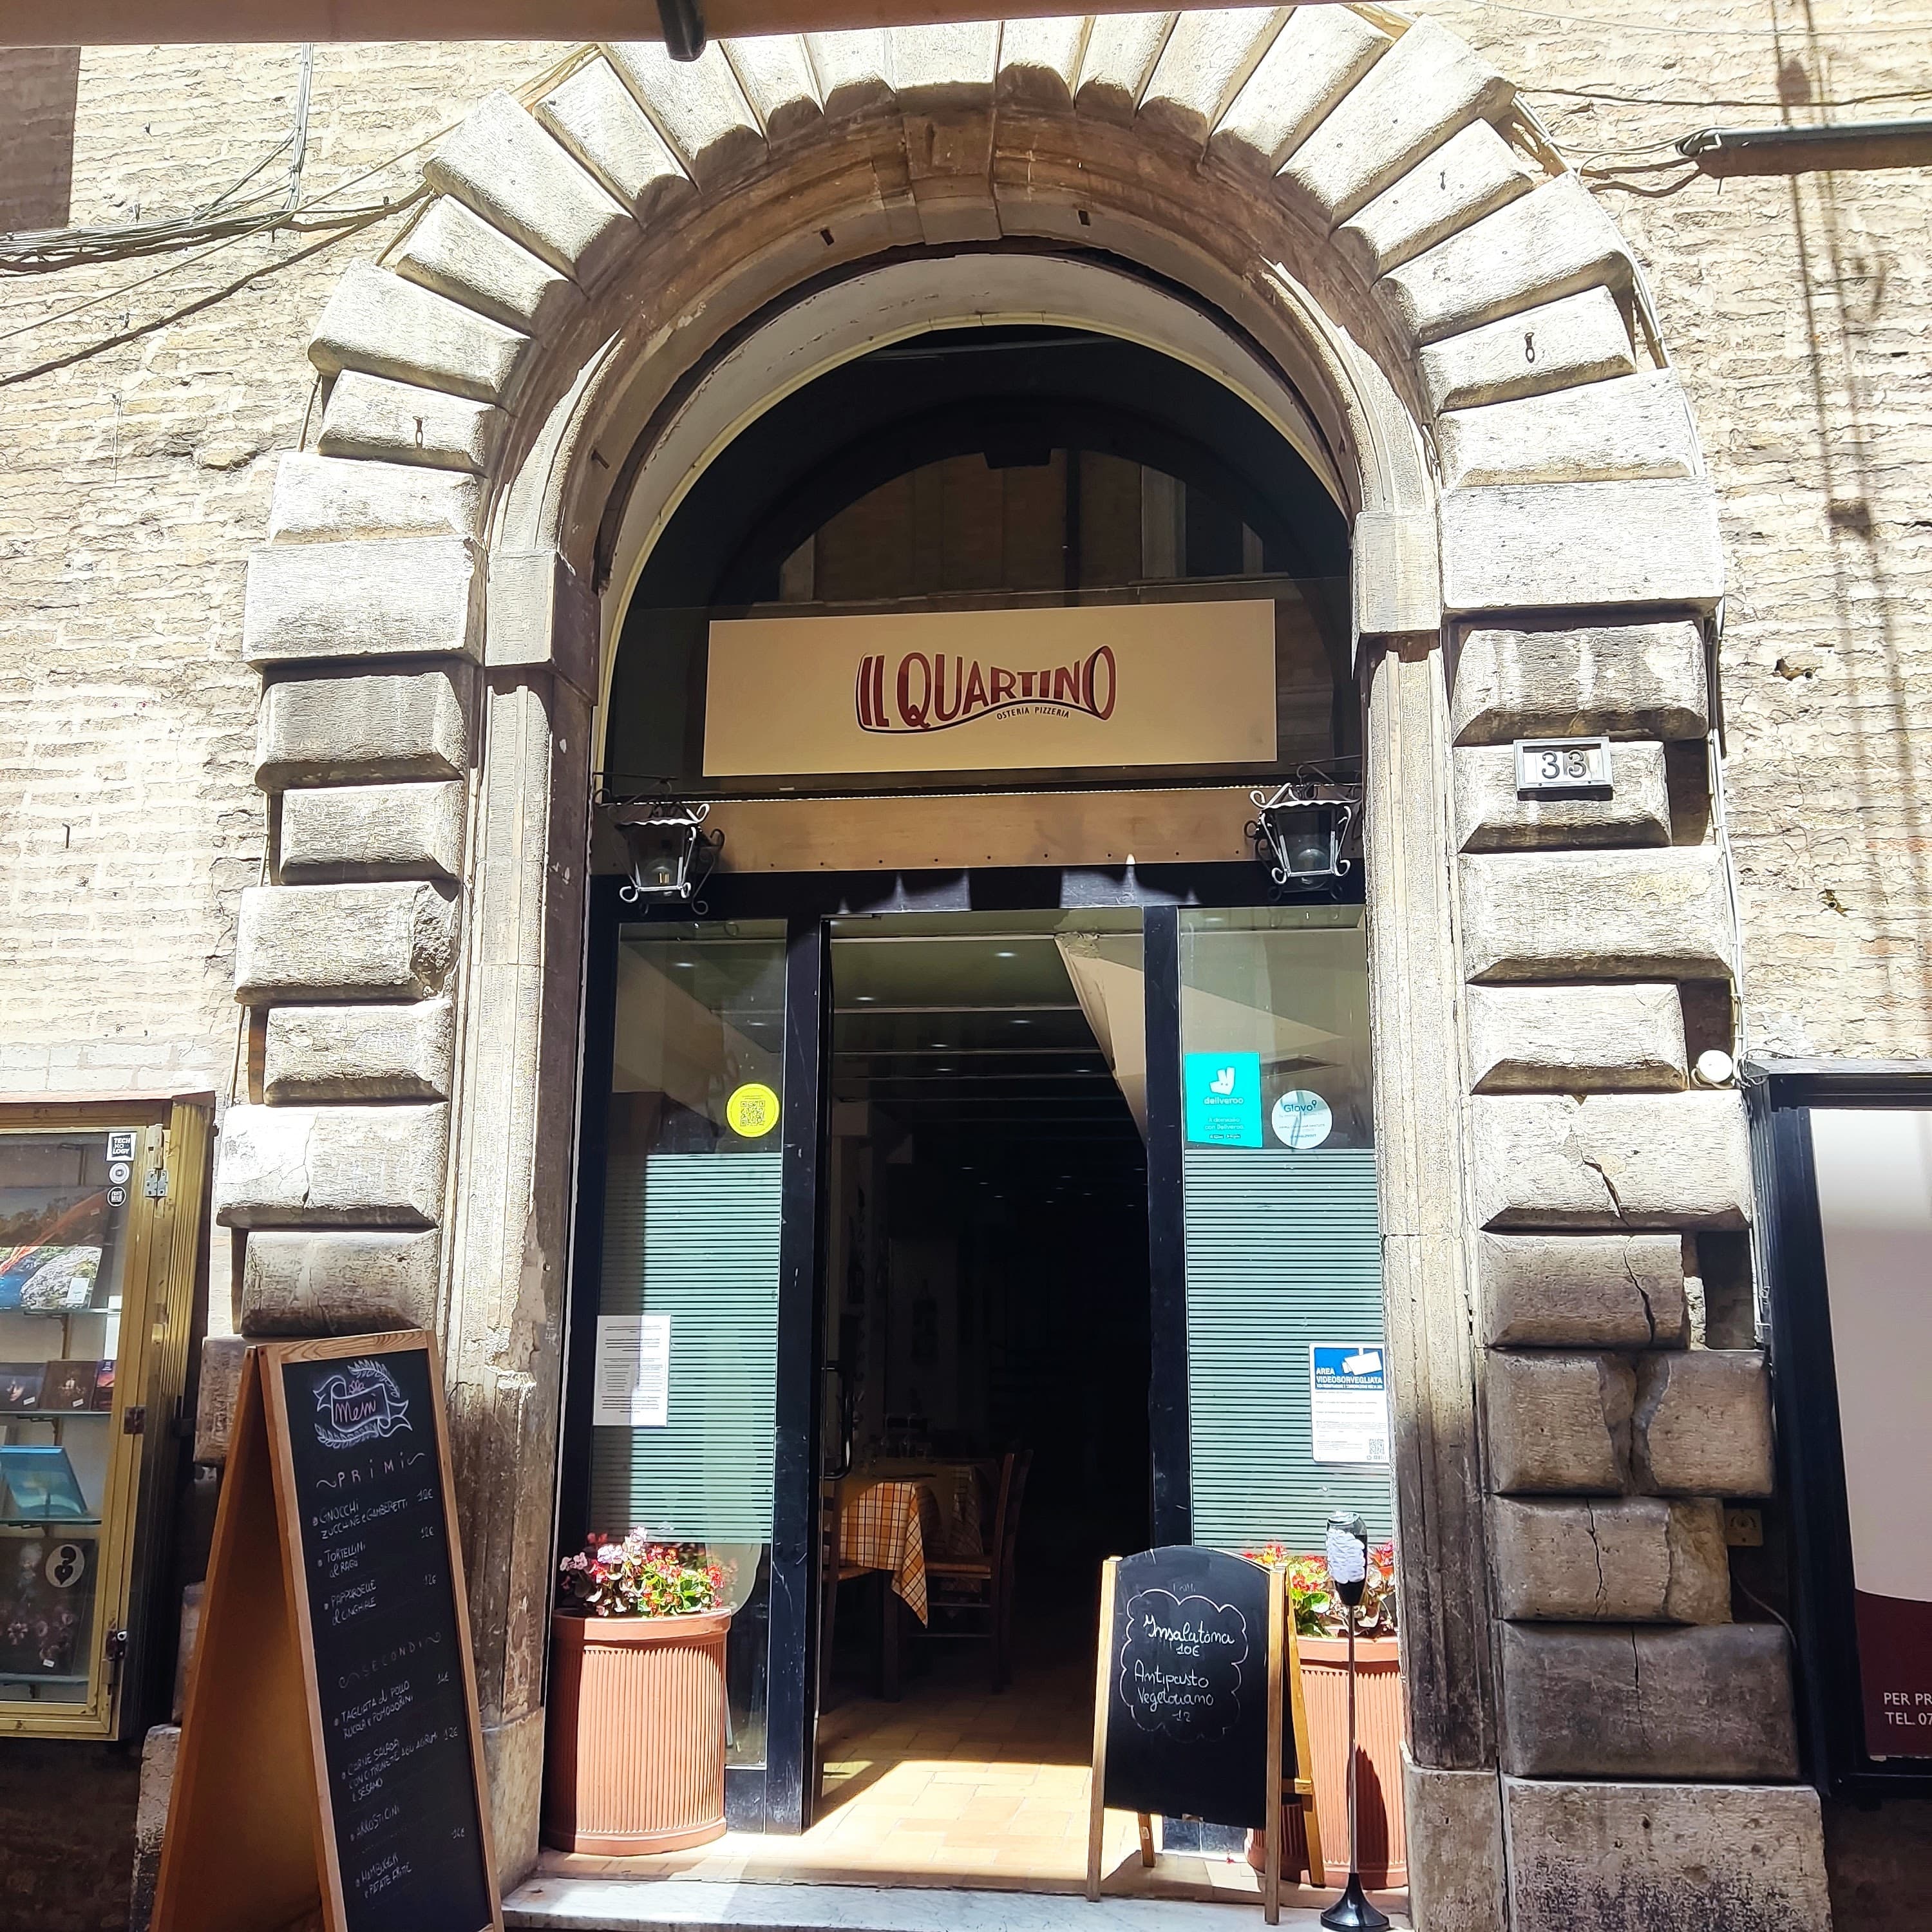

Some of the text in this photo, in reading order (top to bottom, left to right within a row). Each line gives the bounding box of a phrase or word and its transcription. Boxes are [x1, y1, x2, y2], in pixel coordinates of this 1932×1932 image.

[860, 645, 1115, 729] IL QUARTINO
[996, 706, 1069, 720] OSTERIA PIZZERIA
[1541, 750, 1587, 779] 33
[1203, 1096, 1244, 1105] deliveroo
[1283, 1104, 1313, 1113] Glovo
[1316, 1367, 1336, 1376] AREA
[1316, 1376, 1383, 1384] VIDEOSORVEGLIATA
[1175, 1644, 1200, 1656] 10€
[1134, 1659, 1209, 1692] Antipasto
[1884, 1692, 1911, 1705] PER
